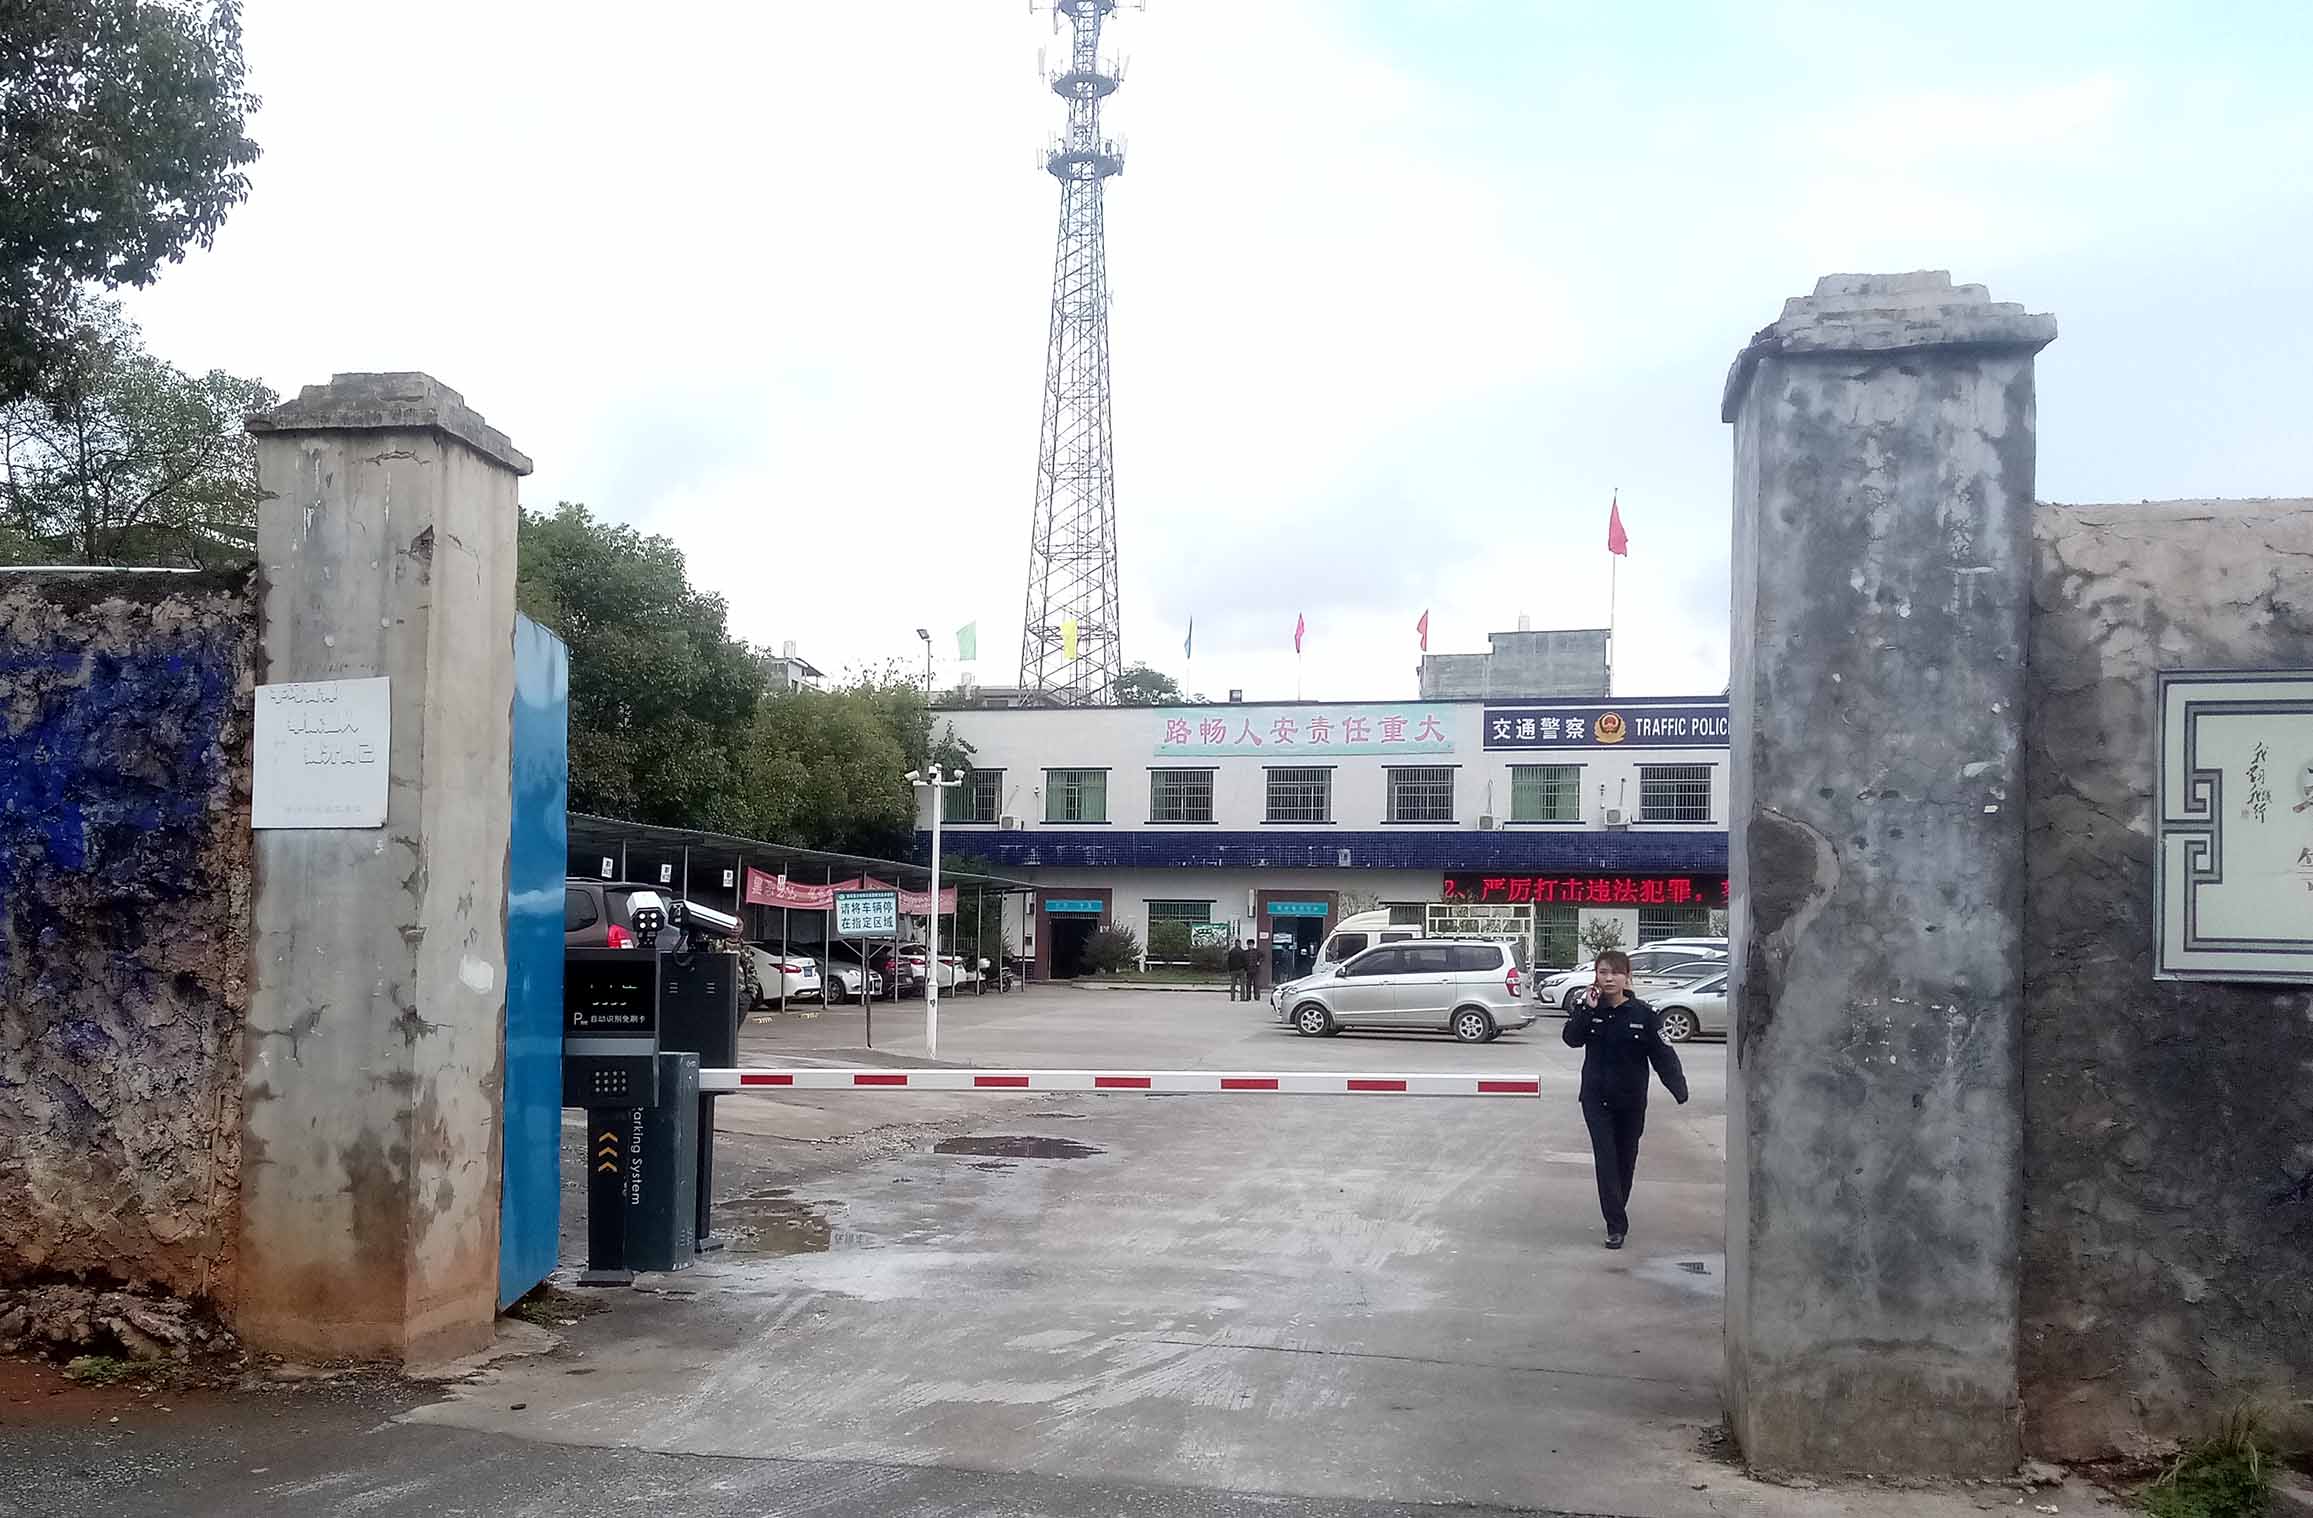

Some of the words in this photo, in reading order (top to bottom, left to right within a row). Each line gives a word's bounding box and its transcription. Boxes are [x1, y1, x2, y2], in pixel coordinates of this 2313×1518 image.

[1163, 714, 1448, 746] 路畅人安责任重大
[1492, 717, 1586, 740] 交通警察
[1635, 717, 1687, 737] TRAFFIC
[1691, 716, 1730, 736] POLIC
[840, 901, 894, 915] 请将车辆停
[841, 915, 894, 929] 在指定区域
[630, 1157, 643, 1205] System
